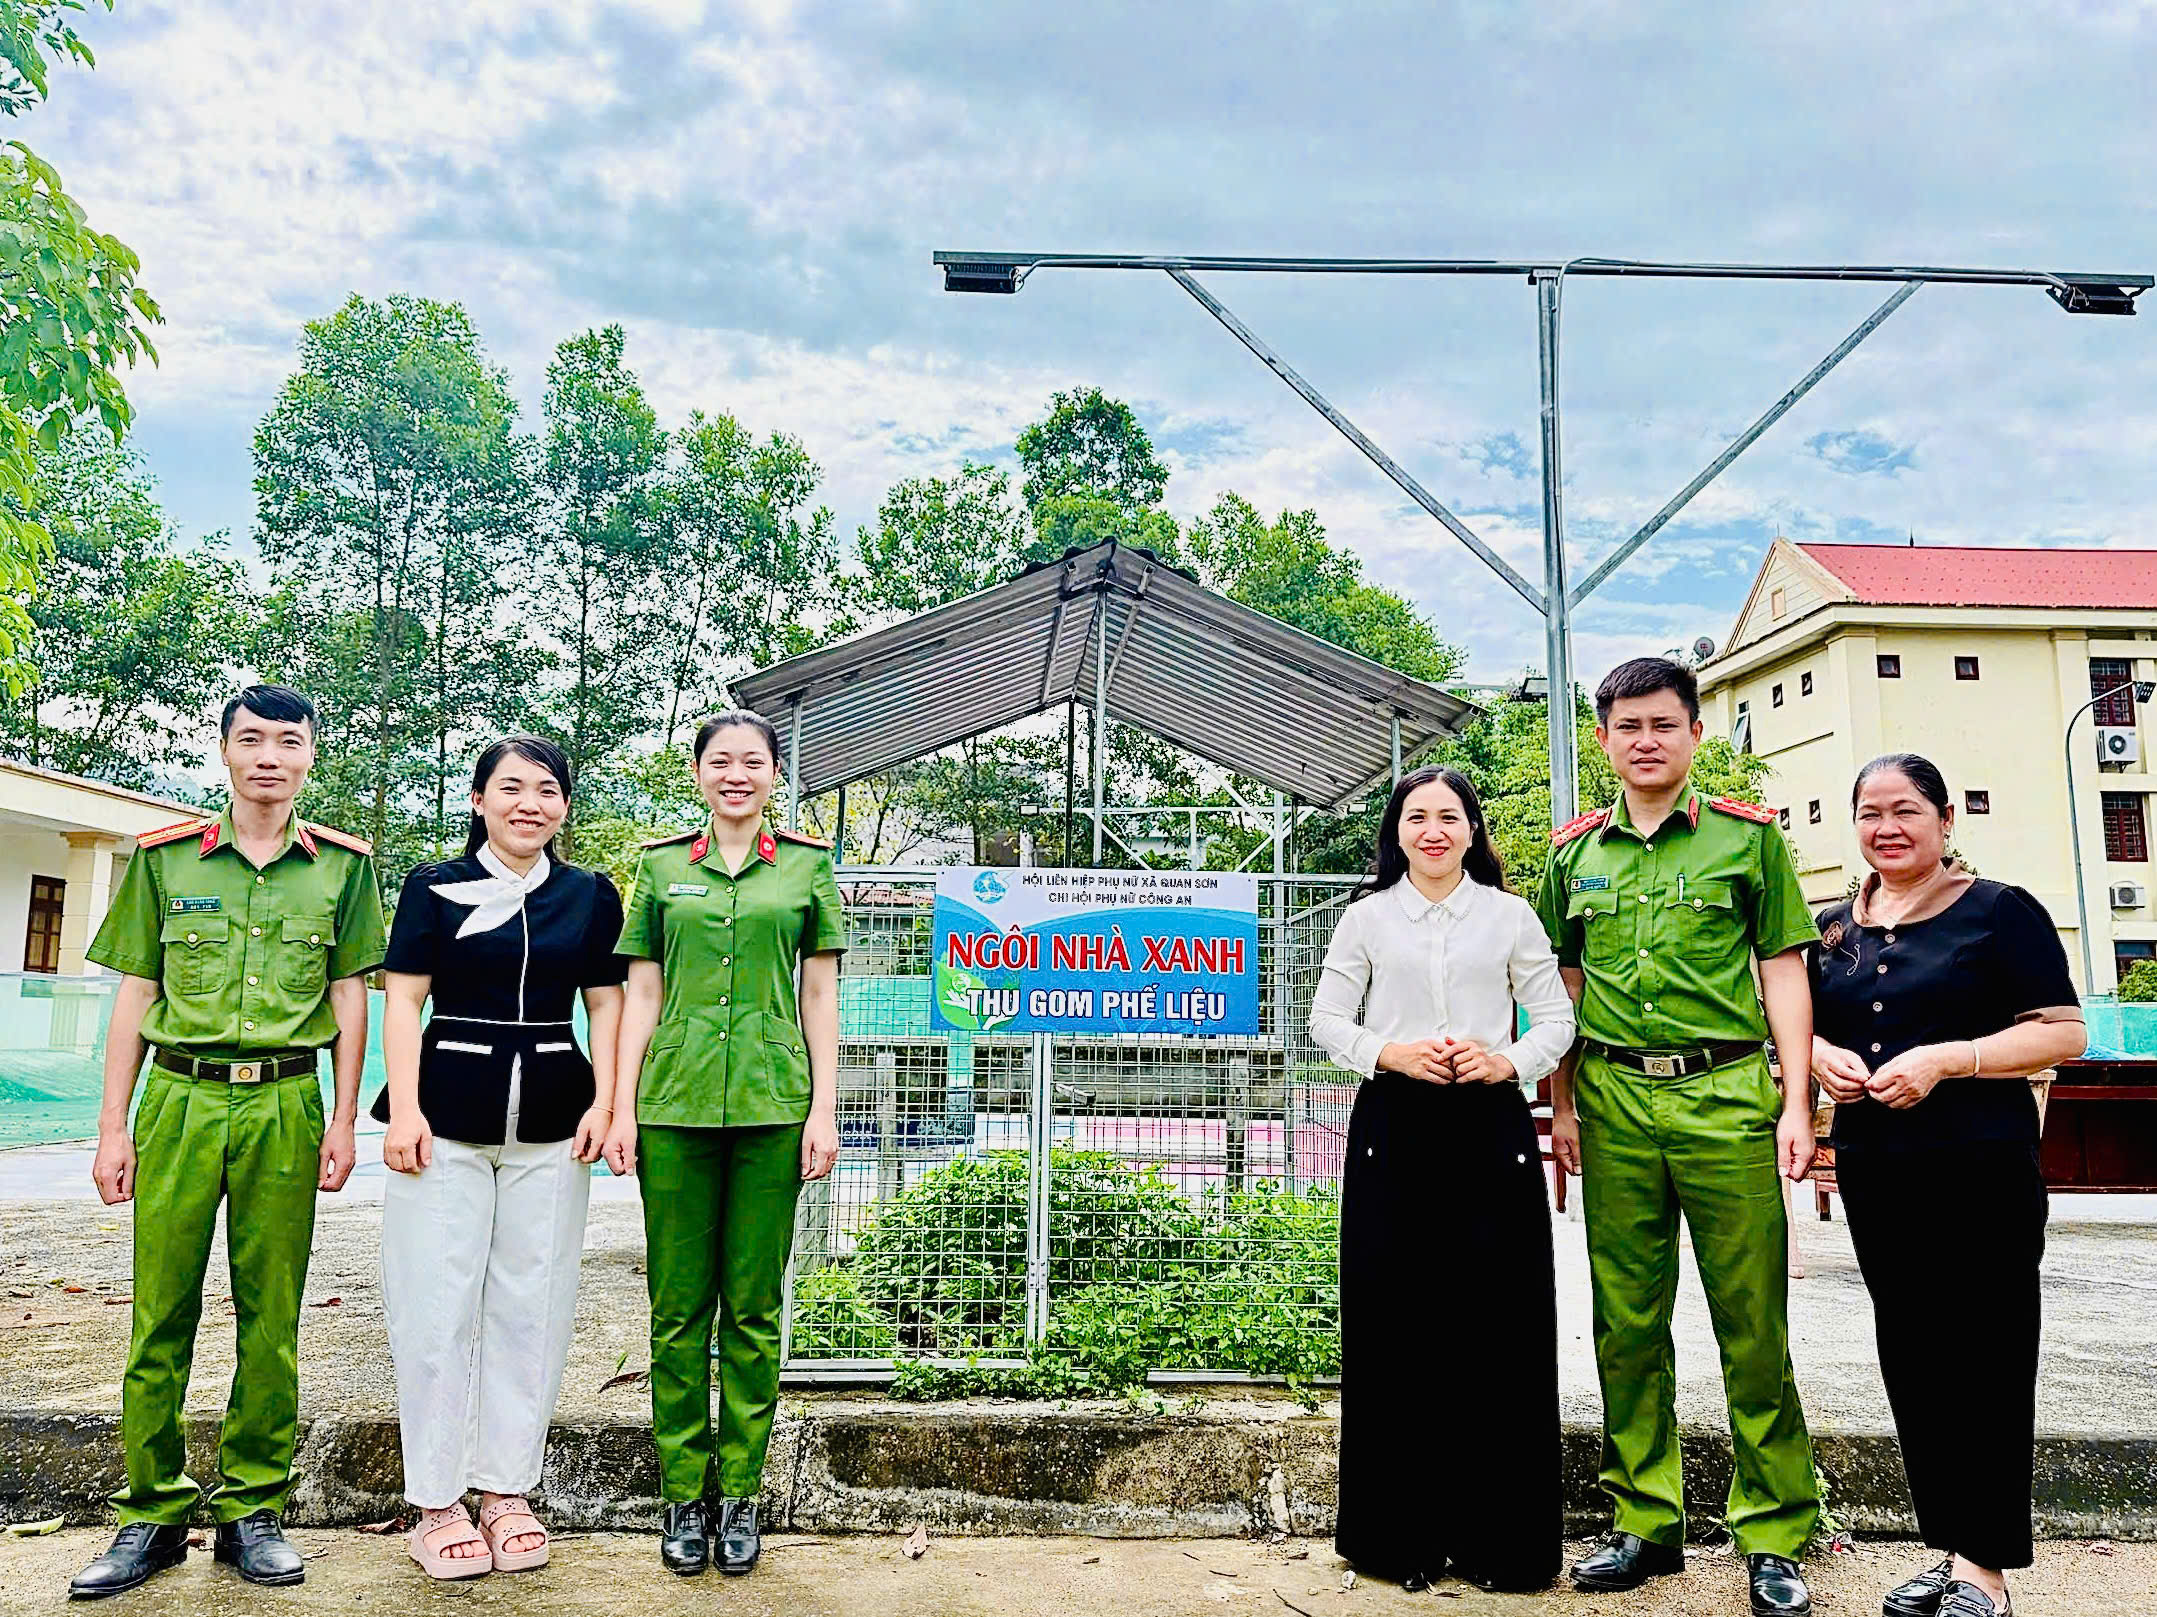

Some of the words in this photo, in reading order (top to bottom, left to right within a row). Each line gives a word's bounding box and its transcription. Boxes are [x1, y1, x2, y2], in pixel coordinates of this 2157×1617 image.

[1022, 872, 1042, 888] HỘI
[1071, 874, 1095, 889] HIỆP
[1098, 876, 1120, 890] PHỤ
[1160, 877, 1192, 889] QUAN
[1194, 877, 1218, 889] SƠN
[1048, 892, 1069, 903] CHI
[1071, 890, 1092, 906] HỘI
[1095, 893, 1117, 906] PHỤ
[1139, 891, 1173, 905] CÔNG
[1176, 895, 1192, 906] AN
[948, 924, 1039, 970] NGÔI
[1052, 925, 1131, 971] NHÀ
[1141, 935, 1245, 974] XANH
[966, 988, 1020, 1016] THU
[1029, 989, 1093, 1018] GOM
[1101, 983, 1159, 1019] PHẾ
[1165, 987, 1226, 1026] LIỆU
